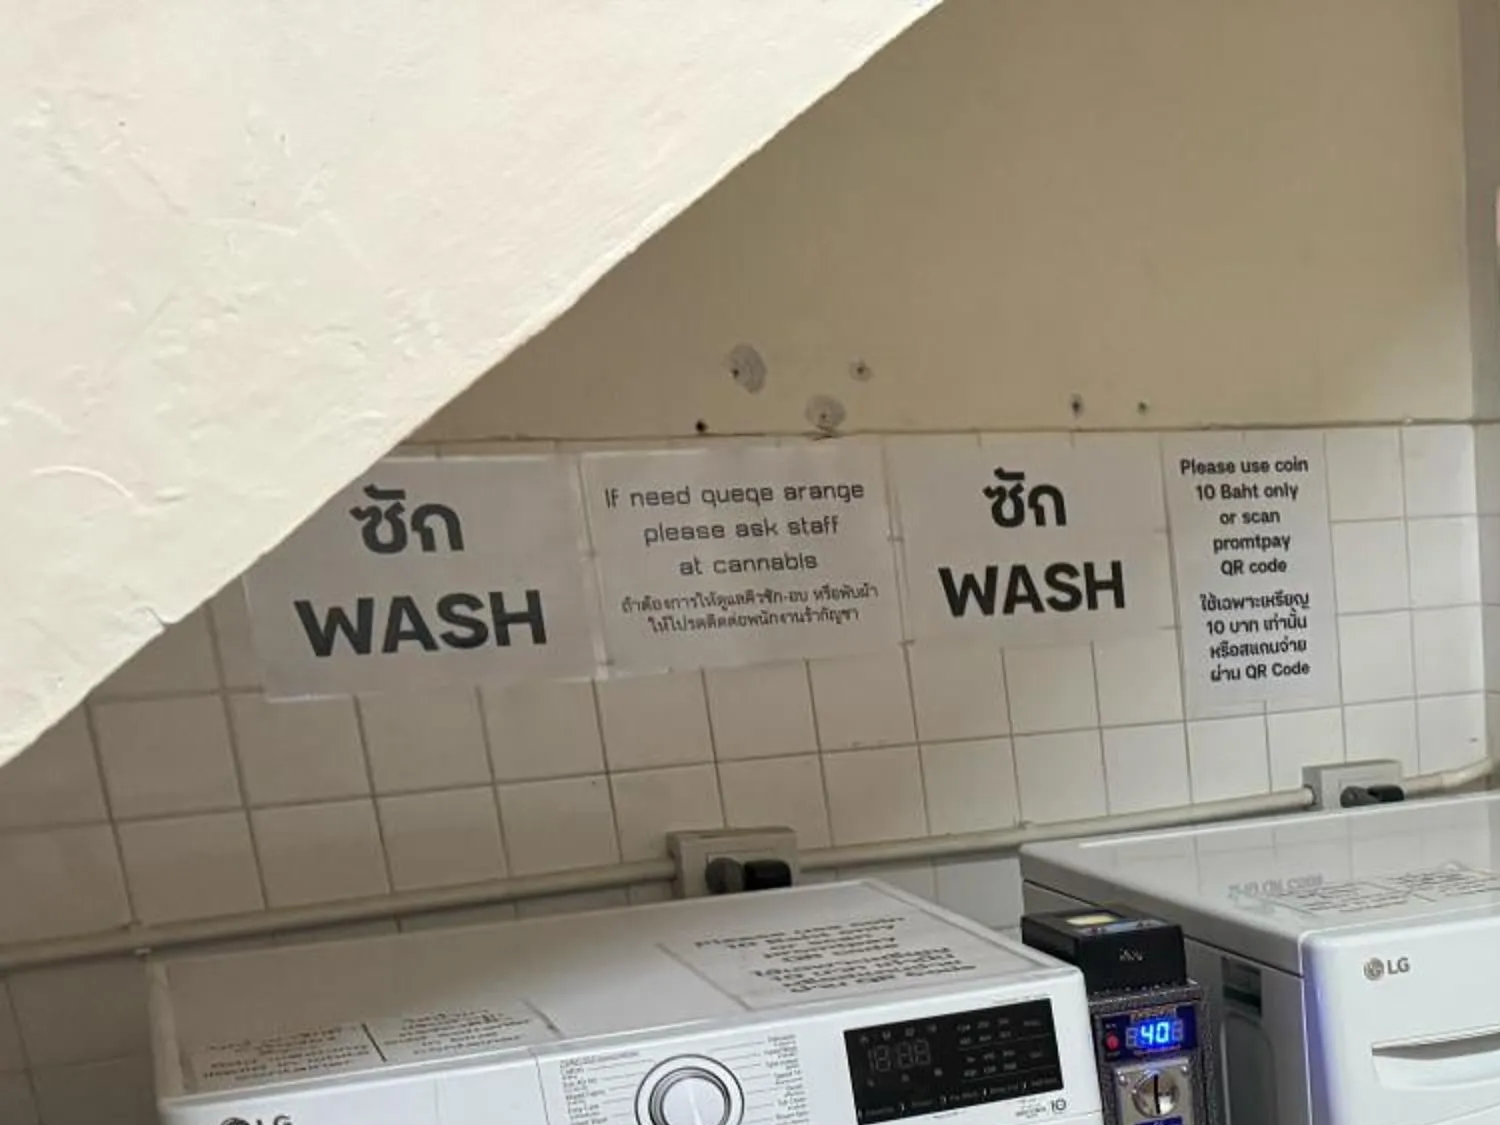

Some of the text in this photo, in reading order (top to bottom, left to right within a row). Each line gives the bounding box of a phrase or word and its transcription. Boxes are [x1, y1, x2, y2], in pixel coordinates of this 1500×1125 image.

[1180, 455, 1309, 475] Please use coin
[604, 487, 620, 508] If
[630, 485, 691, 507] need
[981, 467, 1067, 528] ซัก
[1196, 481, 1299, 501] 10 Baht only
[350, 483, 464, 555] ซัก
[1219, 510, 1281, 525] or scan
[644, 515, 839, 547] please ask staff
[1213, 534, 1291, 555] promtpay
[680, 551, 819, 577] at cannabis
[1220, 557, 1288, 576] QR code
[937, 560, 1126, 618] WASH
[293, 589, 548, 658] WASH
[1206, 607, 1308, 635] 10 บาท เท่านั้น
[1210, 660, 1311, 682] ผ่าน QR Code
[1387, 957, 1410, 975] LG
[1140, 1021, 1170, 1046] 40
